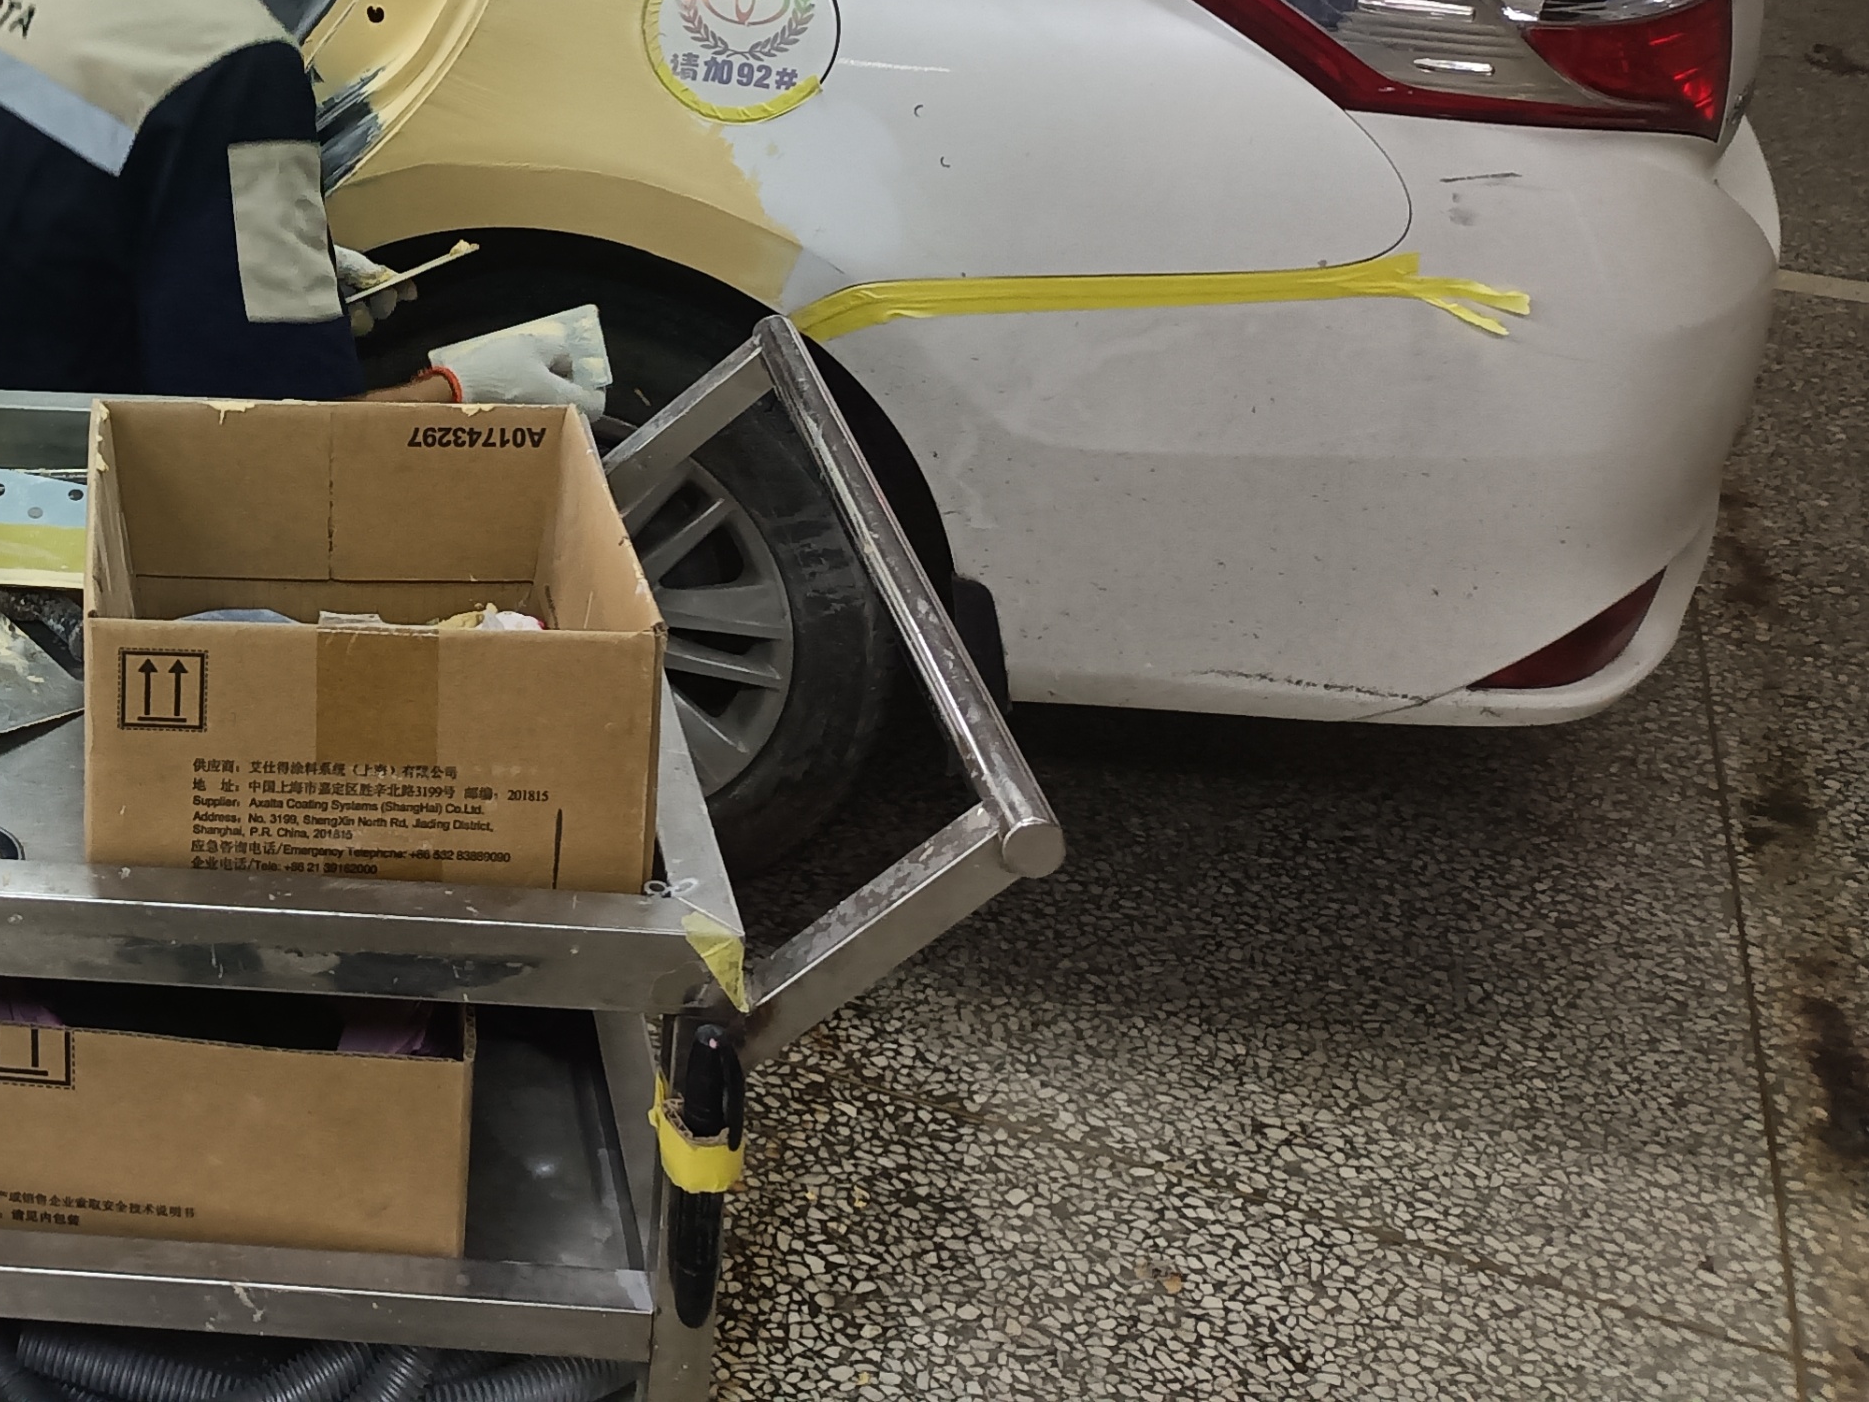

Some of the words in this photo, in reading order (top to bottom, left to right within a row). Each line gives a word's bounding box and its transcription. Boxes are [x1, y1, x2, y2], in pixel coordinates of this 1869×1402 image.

[670, 52, 798, 90] 请加92#
[407, 427, 546, 448] A01743297
[507, 789, 549, 802] 201815
[249, 798, 284, 809] Axalta
[286, 799, 328, 812] Coating
[331, 800, 378, 812] Systems
[381, 802, 442, 815] (ShangHai)
[248, 813, 266, 823] No.
[358, 816, 387, 827] North
[193, 824, 245, 837] Shanghai,
[277, 827, 309, 839] China,
[307, 862, 320, 873] 21
